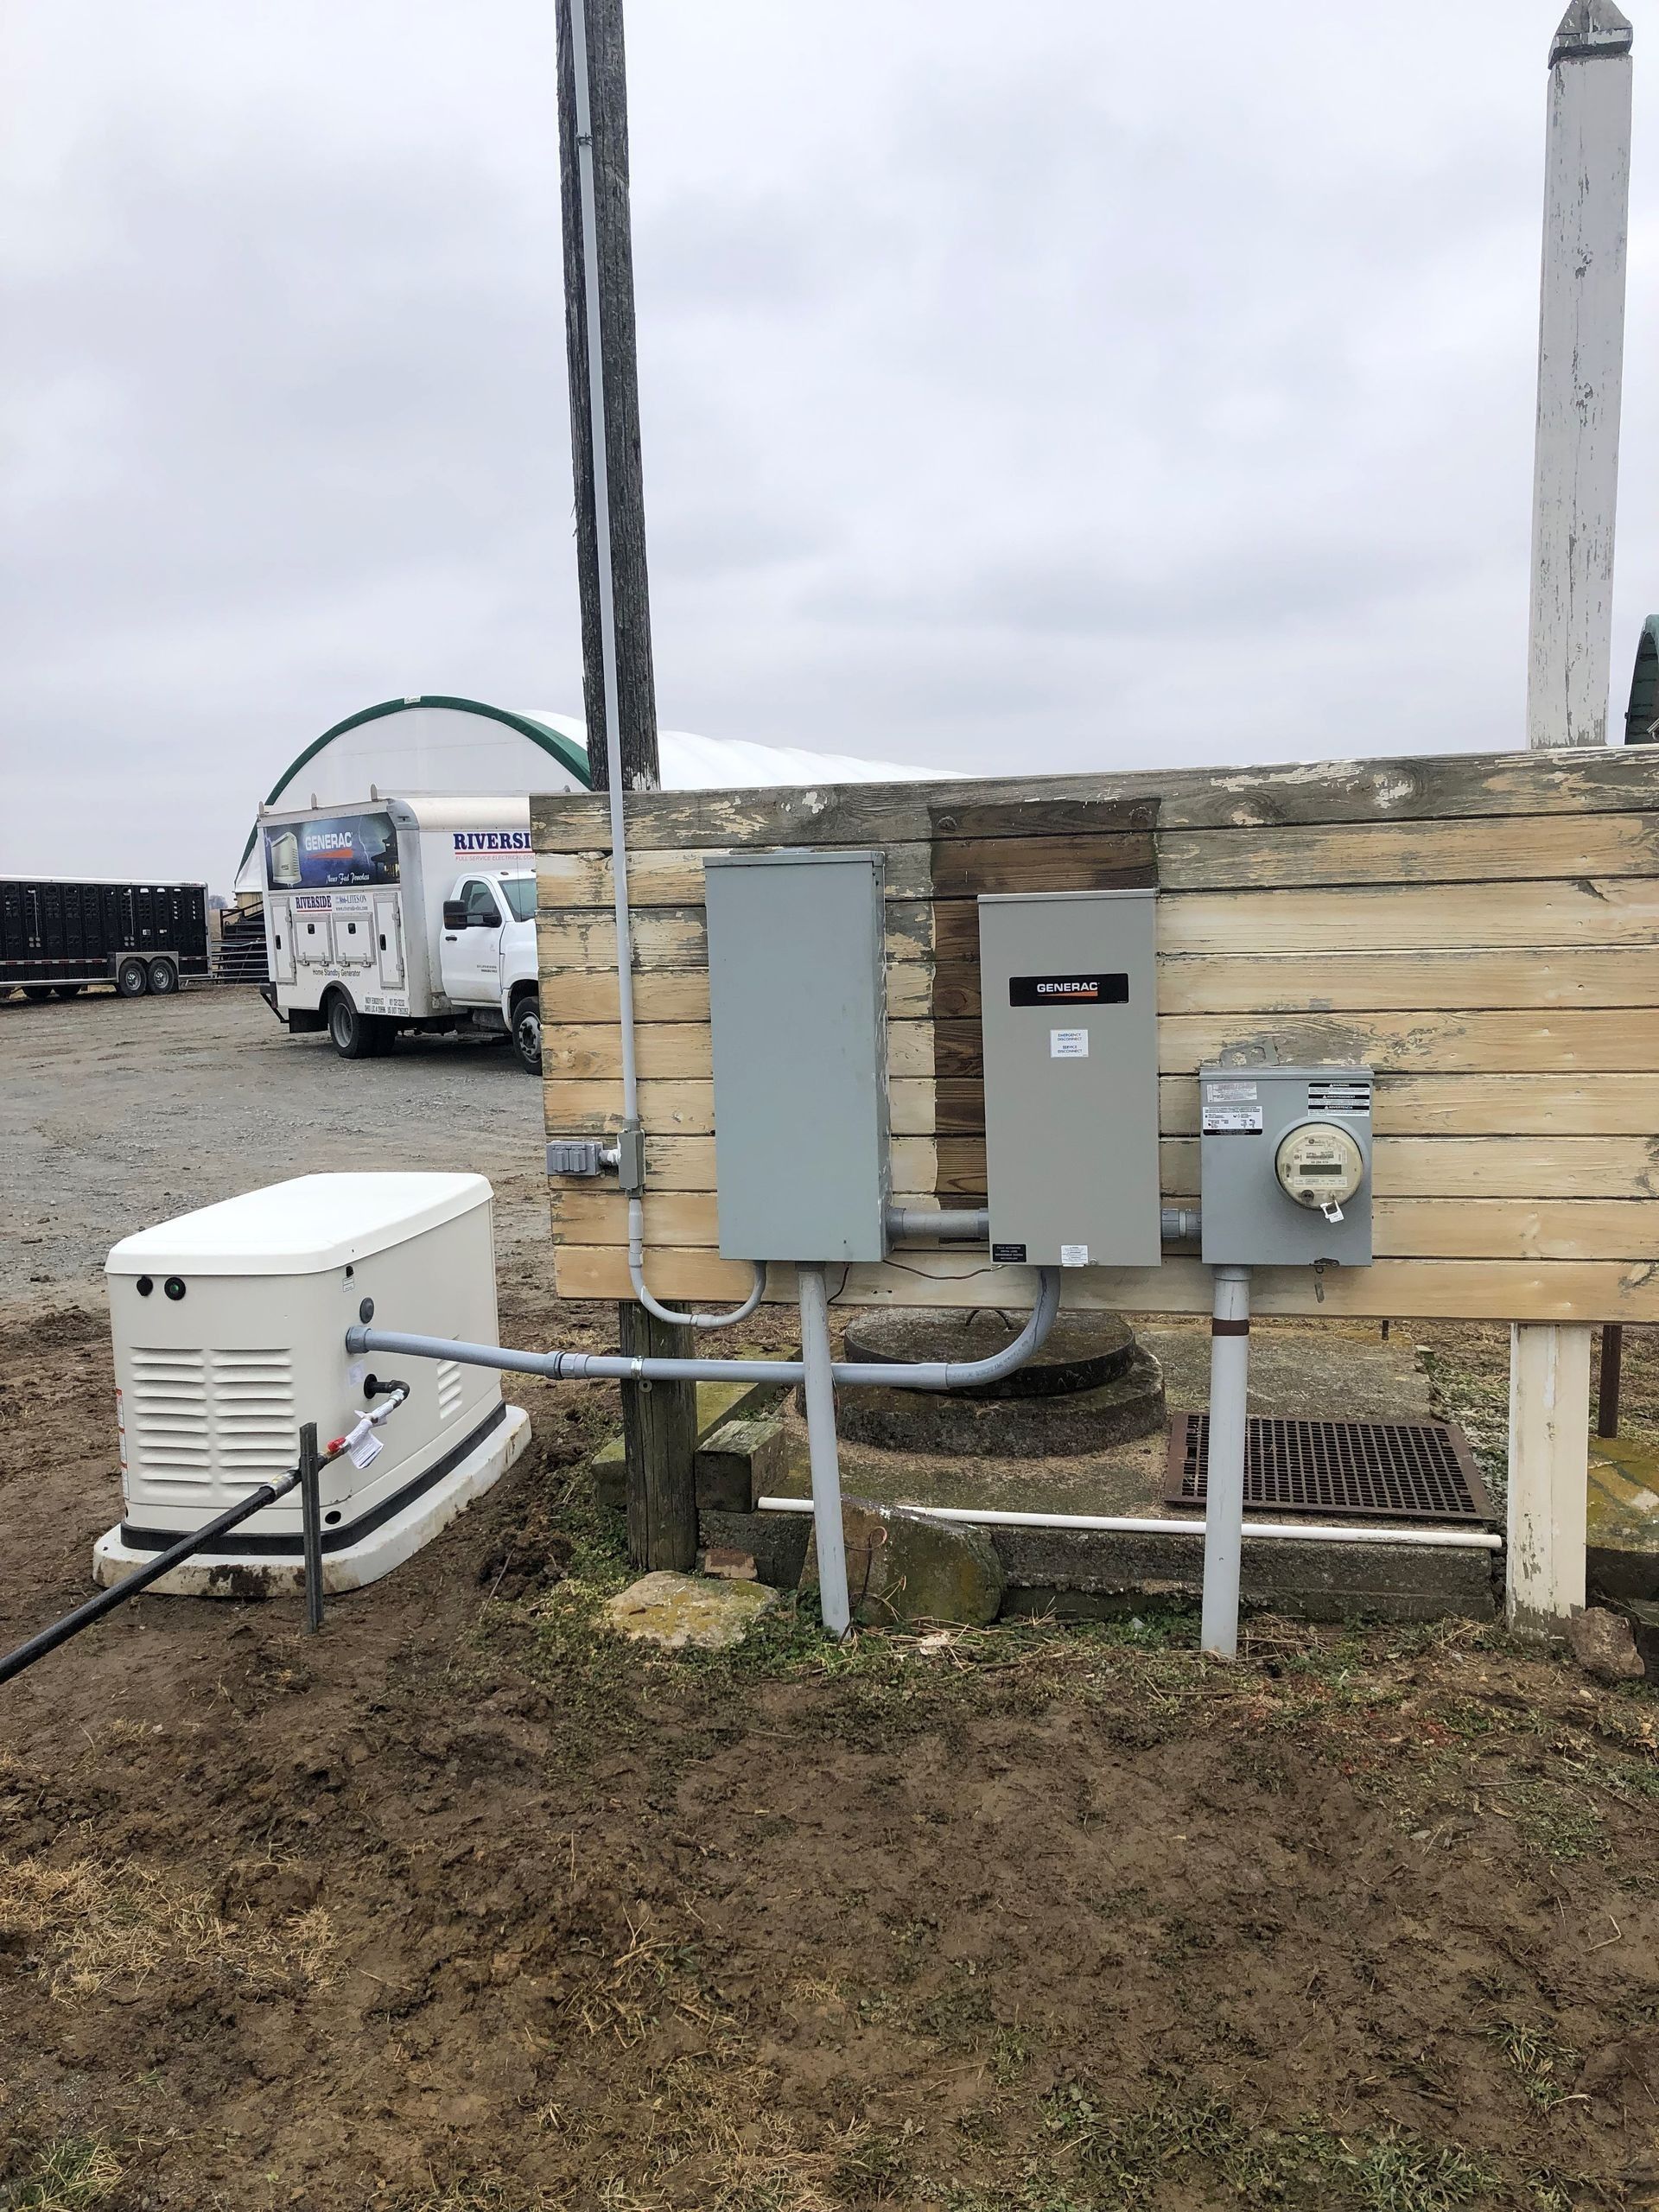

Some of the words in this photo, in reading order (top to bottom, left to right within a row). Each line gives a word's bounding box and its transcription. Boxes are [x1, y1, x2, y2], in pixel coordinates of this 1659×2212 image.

[305, 832, 352, 851] GENERAC
[453, 833, 531, 849] RIVERSI
[296, 895, 332, 909] RIVERSIDE
[313, 968, 323, 976] Home
[340, 969, 360, 977] Generator
[1037, 982, 1098, 992] GENERAC
